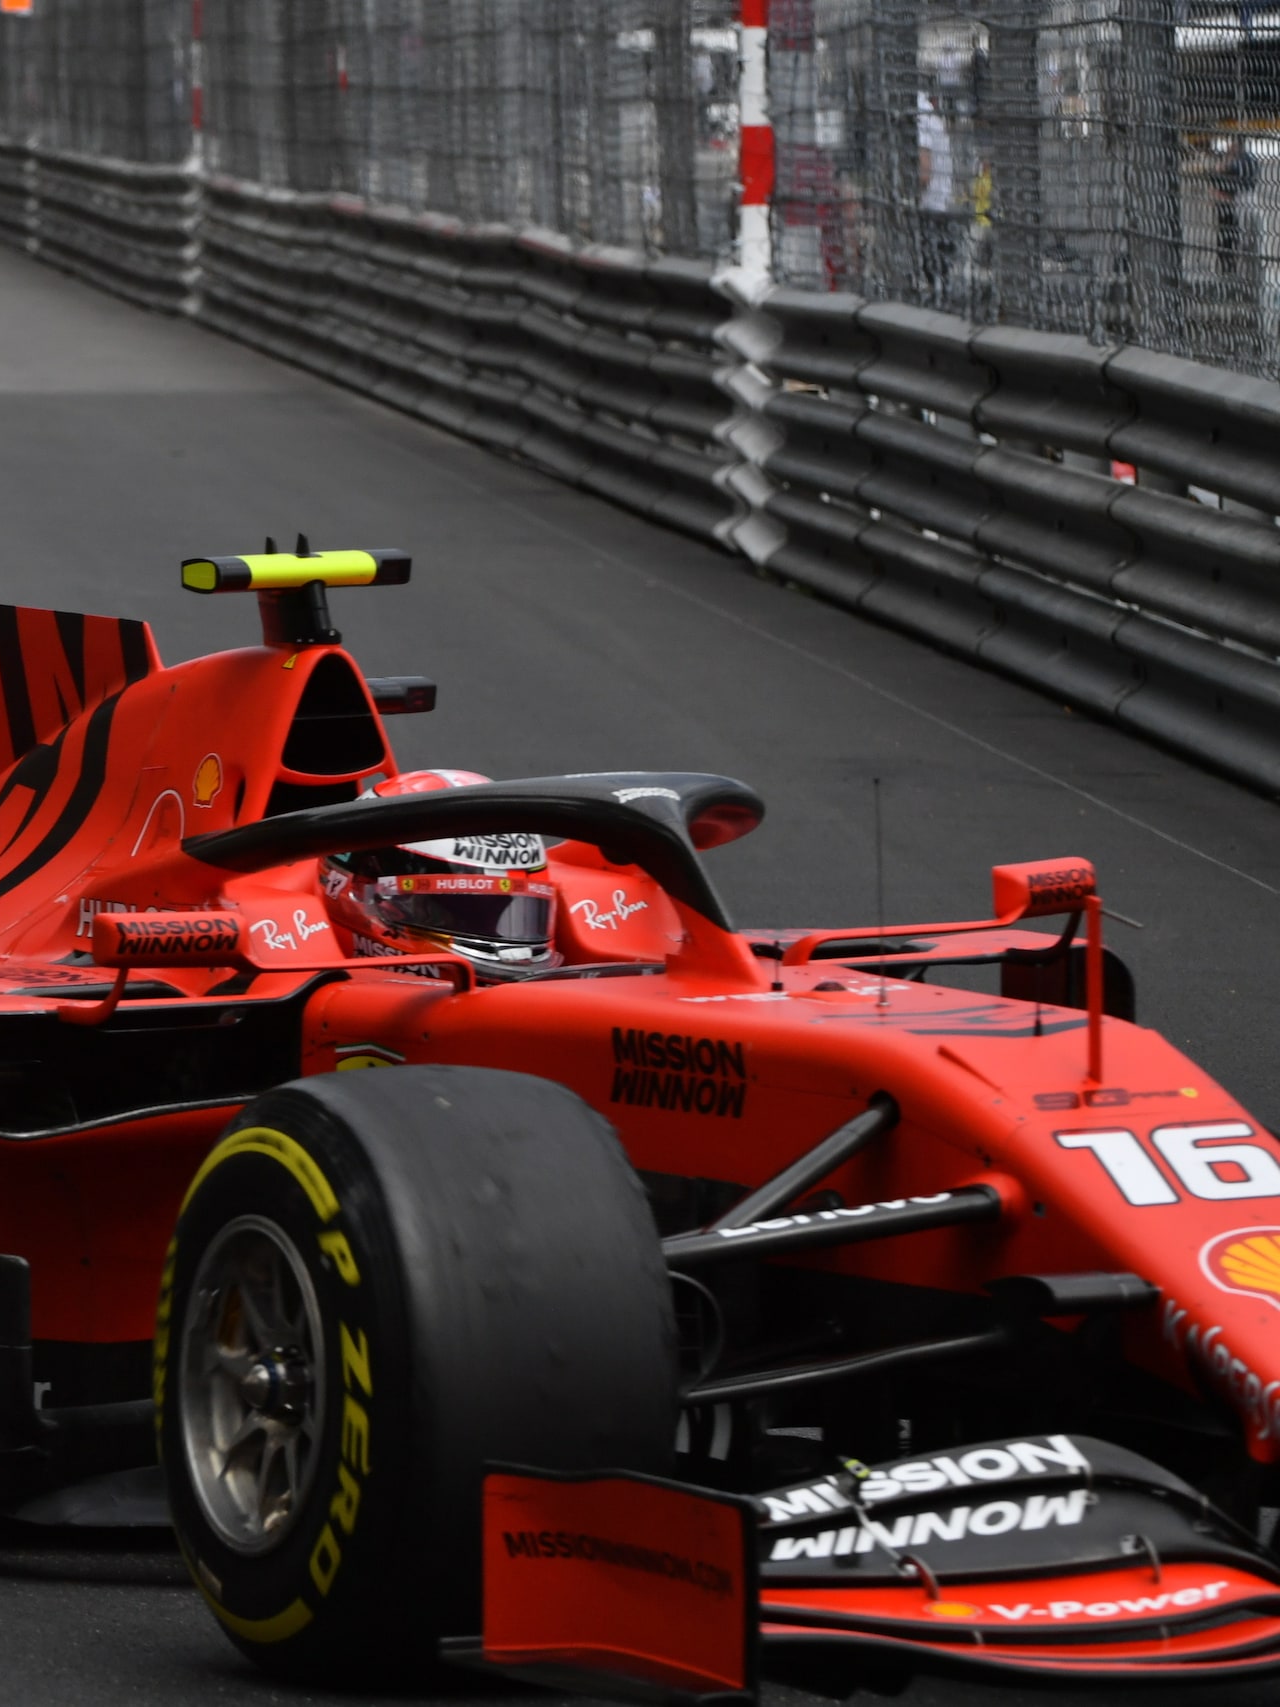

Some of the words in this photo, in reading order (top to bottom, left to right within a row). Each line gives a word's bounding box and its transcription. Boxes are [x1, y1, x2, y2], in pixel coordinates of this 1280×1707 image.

[453, 843, 540, 865] WINNOW
[1028, 868, 1095, 889] MISSION
[436, 879, 494, 890] HUBLOT
[116, 918, 239, 936] MISSION
[116, 933, 239, 955] WINNOW
[612, 1027, 747, 1080] MISSION
[610, 1067, 747, 1119] WINNOW
[1051, 1118, 1280, 1208] 16
[319, 1228, 362, 1288] P
[308, 1319, 374, 1598] ZERO
[761, 1436, 1089, 1522] MISSION
[770, 1489, 1088, 1561] WINNOW
[988, 1580, 1229, 1621] V-Power
